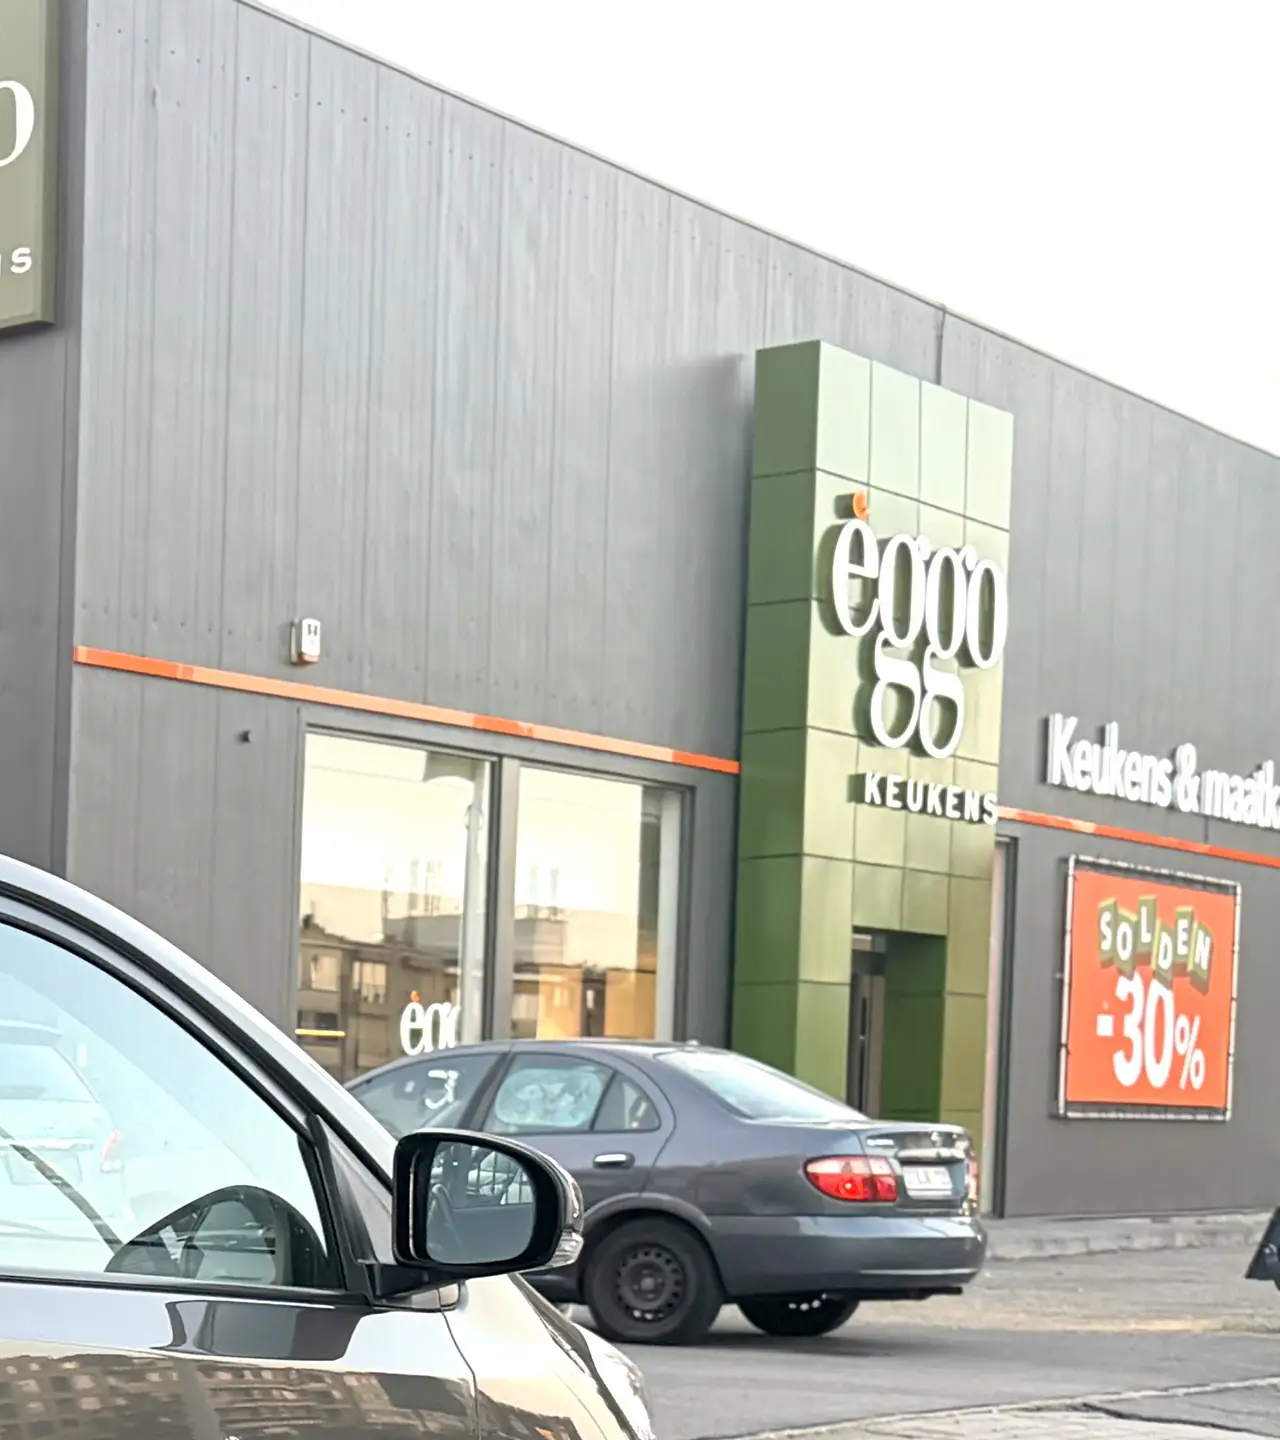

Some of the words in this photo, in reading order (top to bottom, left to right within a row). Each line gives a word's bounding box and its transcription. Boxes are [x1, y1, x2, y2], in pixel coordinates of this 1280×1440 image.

[864, 771, 999, 826] KEUKENS
[1047, 712, 1173, 808] Keukens
[1174, 742, 1200, 813] &
[1099, 903, 1211, 971] SOLDEN
[1096, 972, 1205, 1090] -30%
